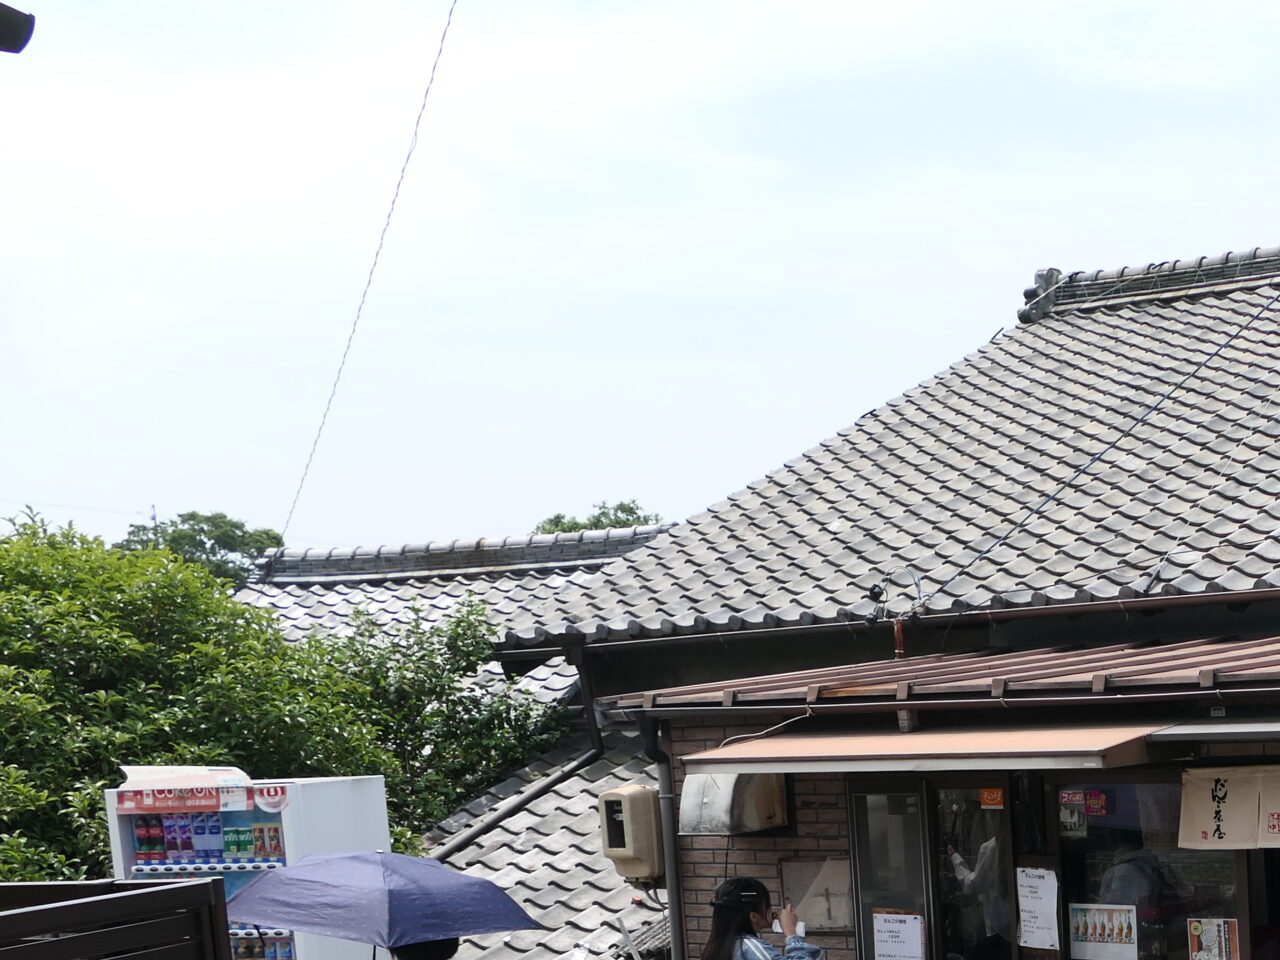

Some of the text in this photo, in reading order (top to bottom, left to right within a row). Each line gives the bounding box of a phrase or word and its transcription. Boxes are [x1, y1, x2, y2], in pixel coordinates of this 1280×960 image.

[1211, 777, 1229, 840] だんご茶屋
